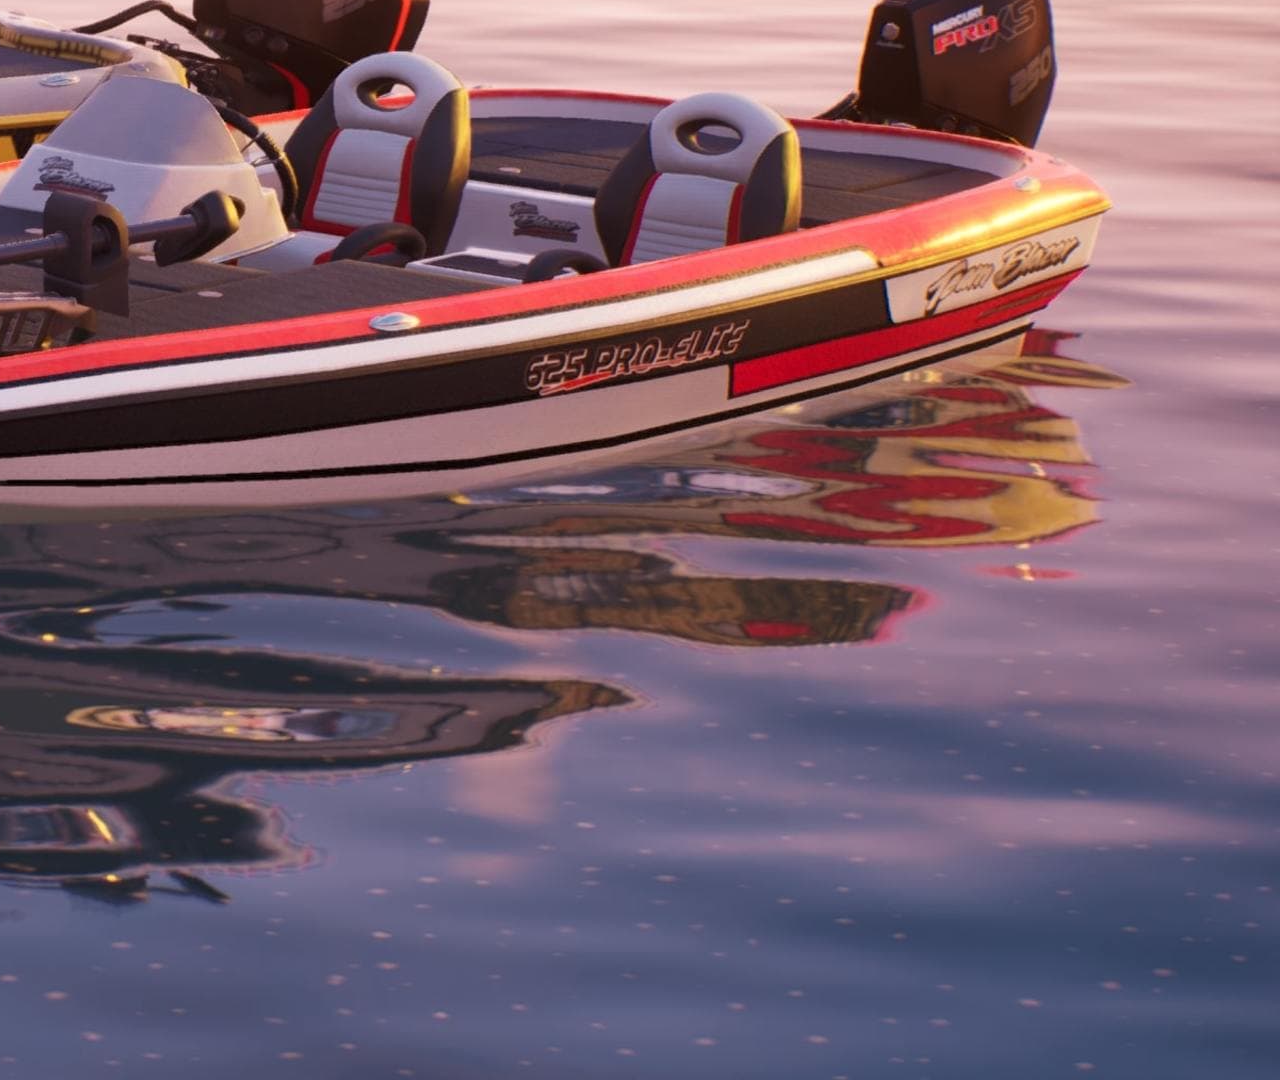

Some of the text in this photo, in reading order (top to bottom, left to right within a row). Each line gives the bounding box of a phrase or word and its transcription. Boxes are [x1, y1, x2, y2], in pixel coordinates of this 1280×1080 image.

[933, 15, 999, 55] PRO
[1009, 46, 1052, 107] 250
[526, 348, 589, 391] 625
